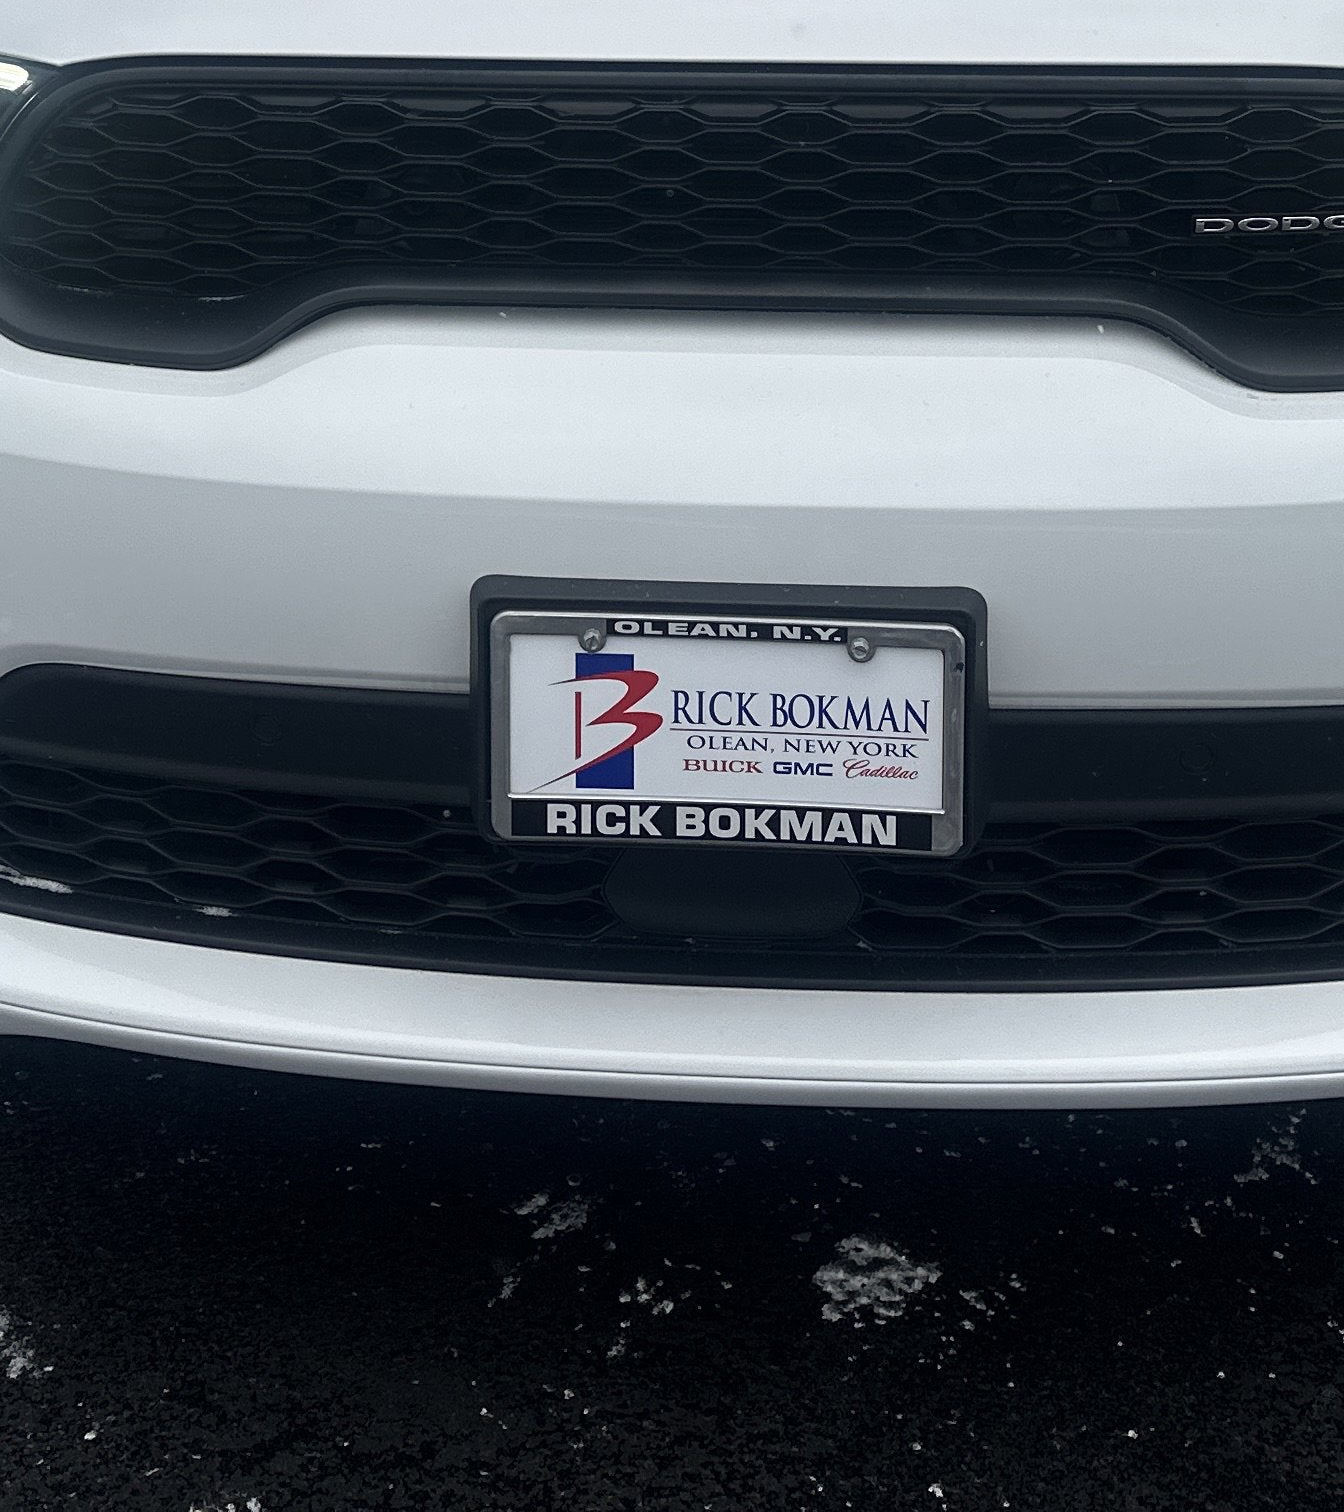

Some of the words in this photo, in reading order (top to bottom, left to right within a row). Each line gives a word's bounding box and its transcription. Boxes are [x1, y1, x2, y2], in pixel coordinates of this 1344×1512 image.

[772, 626, 842, 642] N.Y.
[670, 689, 762, 727] RICK
[770, 693, 930, 735] BOKMAN
[686, 735, 776, 754] OLEAN,
[783, 738, 844, 755] NEW
[846, 741, 919, 759] YORK
[682, 759, 764, 774] BUICK
[772, 762, 834, 777] GMC
[843, 758, 920, 781] Cadillac
[545, 803, 663, 836] RICK
[675, 806, 898, 846] BOKMAN
